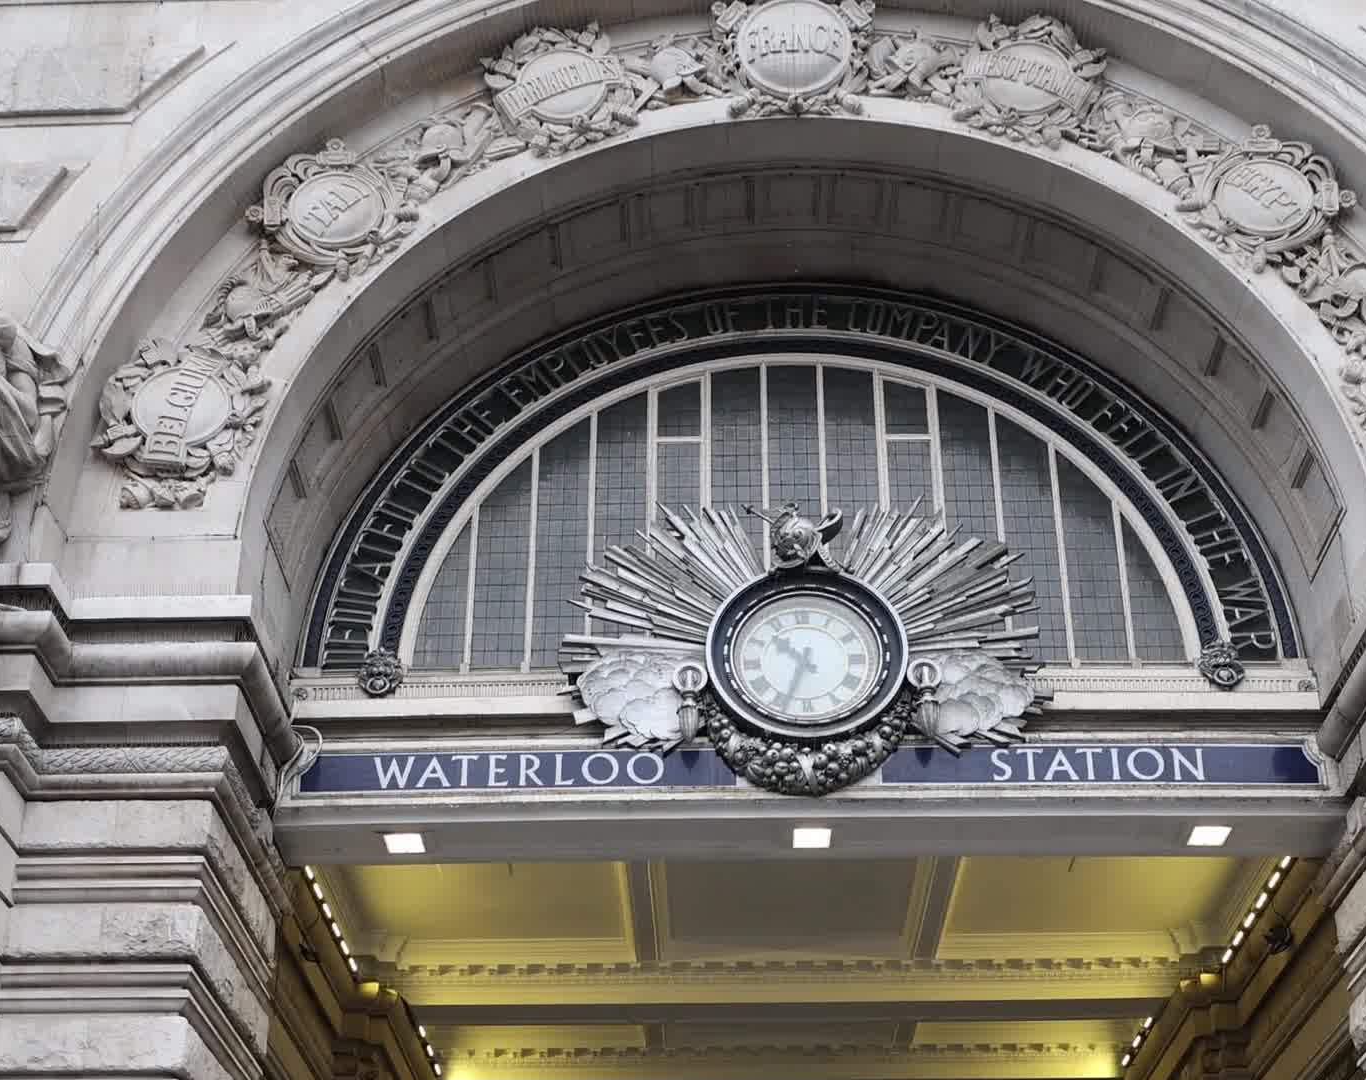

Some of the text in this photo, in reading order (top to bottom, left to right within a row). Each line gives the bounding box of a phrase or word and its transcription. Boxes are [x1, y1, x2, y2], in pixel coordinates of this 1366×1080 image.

[704, 303, 739, 334] OF
[765, 300, 828, 330] THE
[847, 302, 1011, 367] COMPANY
[498, 311, 689, 411] EMPLOYEES
[1018, 350, 1095, 411] WHO
[430, 398, 507, 458] THE
[1183, 498, 1252, 571] THE
[1214, 575, 1277, 654] WAR
[373, 747, 1205, 789] WATERLOO STATION
